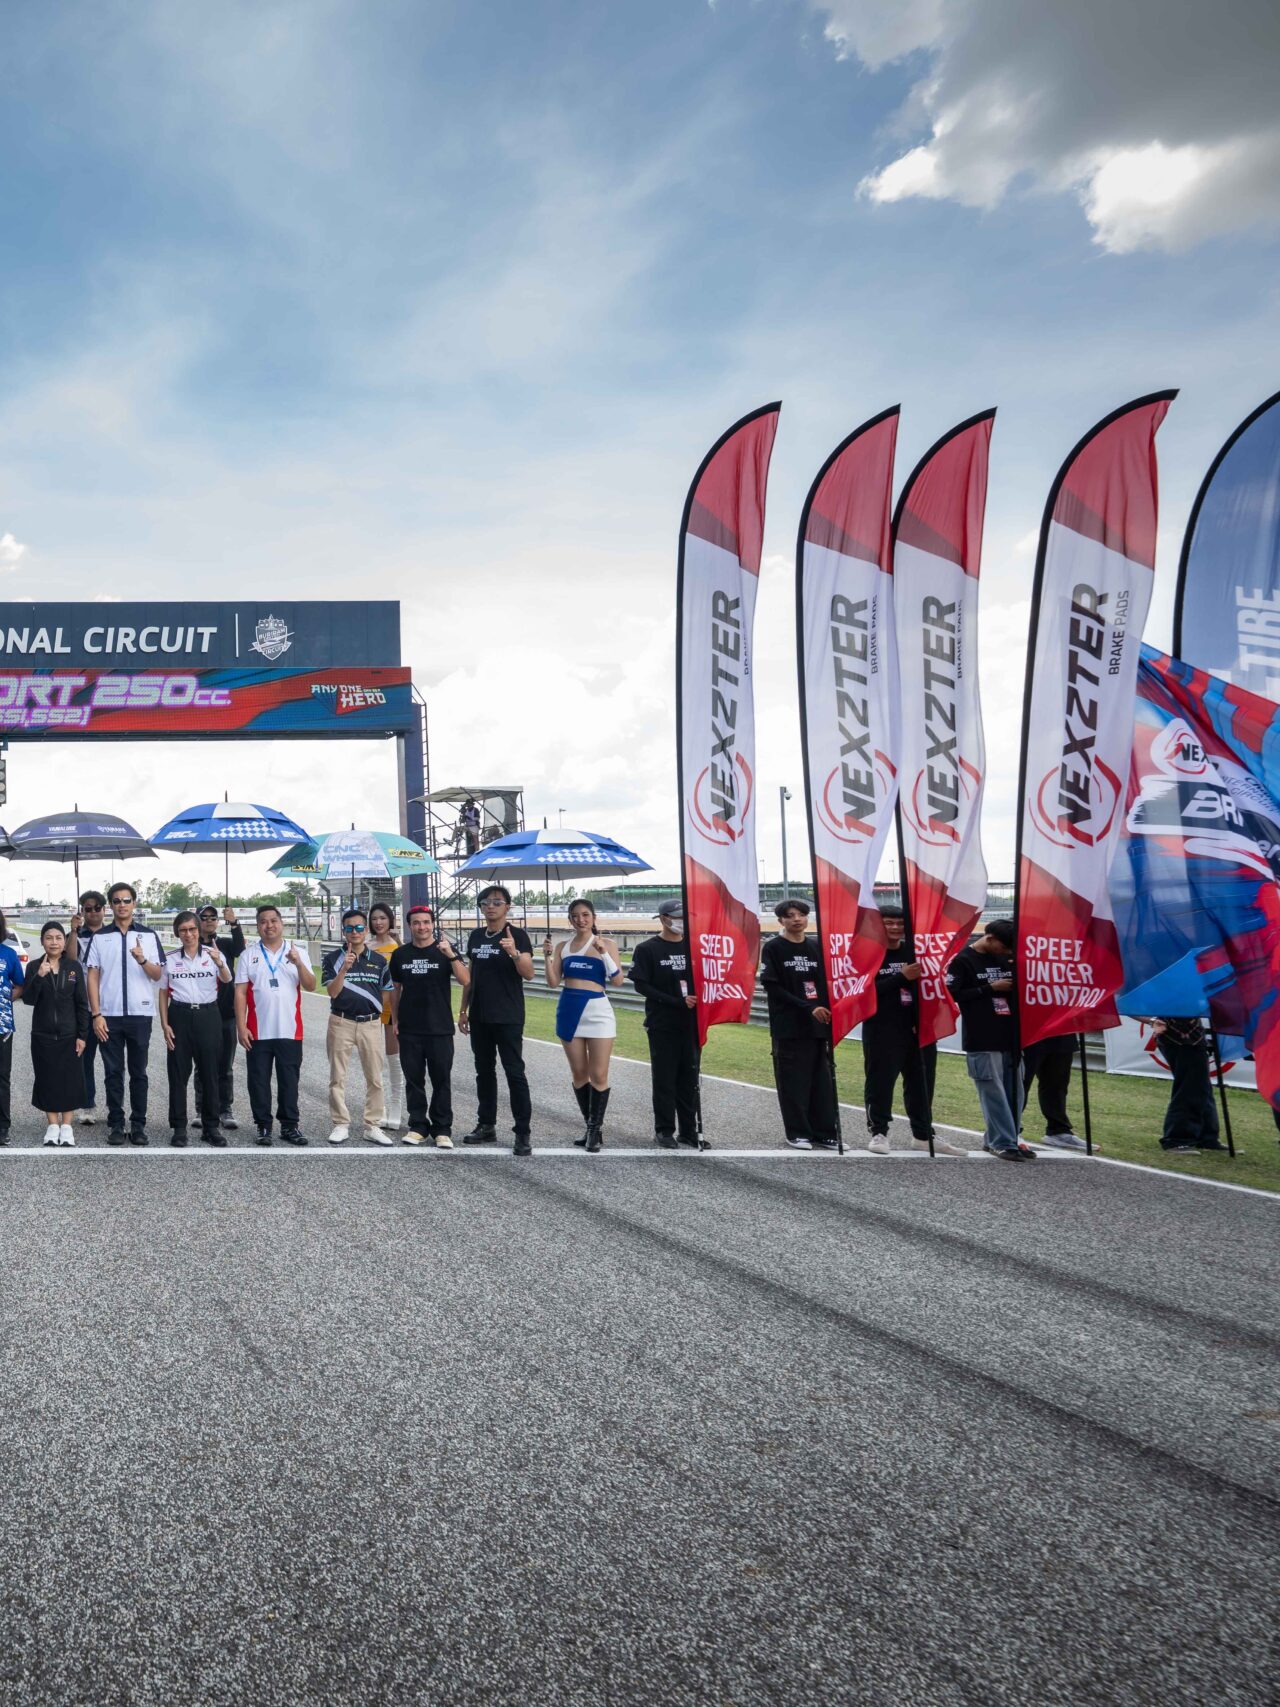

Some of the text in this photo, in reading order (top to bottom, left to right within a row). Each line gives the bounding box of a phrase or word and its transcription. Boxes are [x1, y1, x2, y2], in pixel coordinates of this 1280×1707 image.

[83, 626, 218, 653] CIRCUIT
[1108, 589, 1130, 676] BRAKE PADS
[340, 692, 387, 708] HERO
[710, 590, 741, 841] NEXZTER
[830, 593, 876, 838] NEXZTER
[922, 595, 962, 842] NEXZTER
[1058, 583, 1109, 848] NEXZTER
[172, 972, 214, 980] HONDA
[1025, 960, 1094, 985] UNDER
[1025, 983, 1106, 1008] CONTROL
